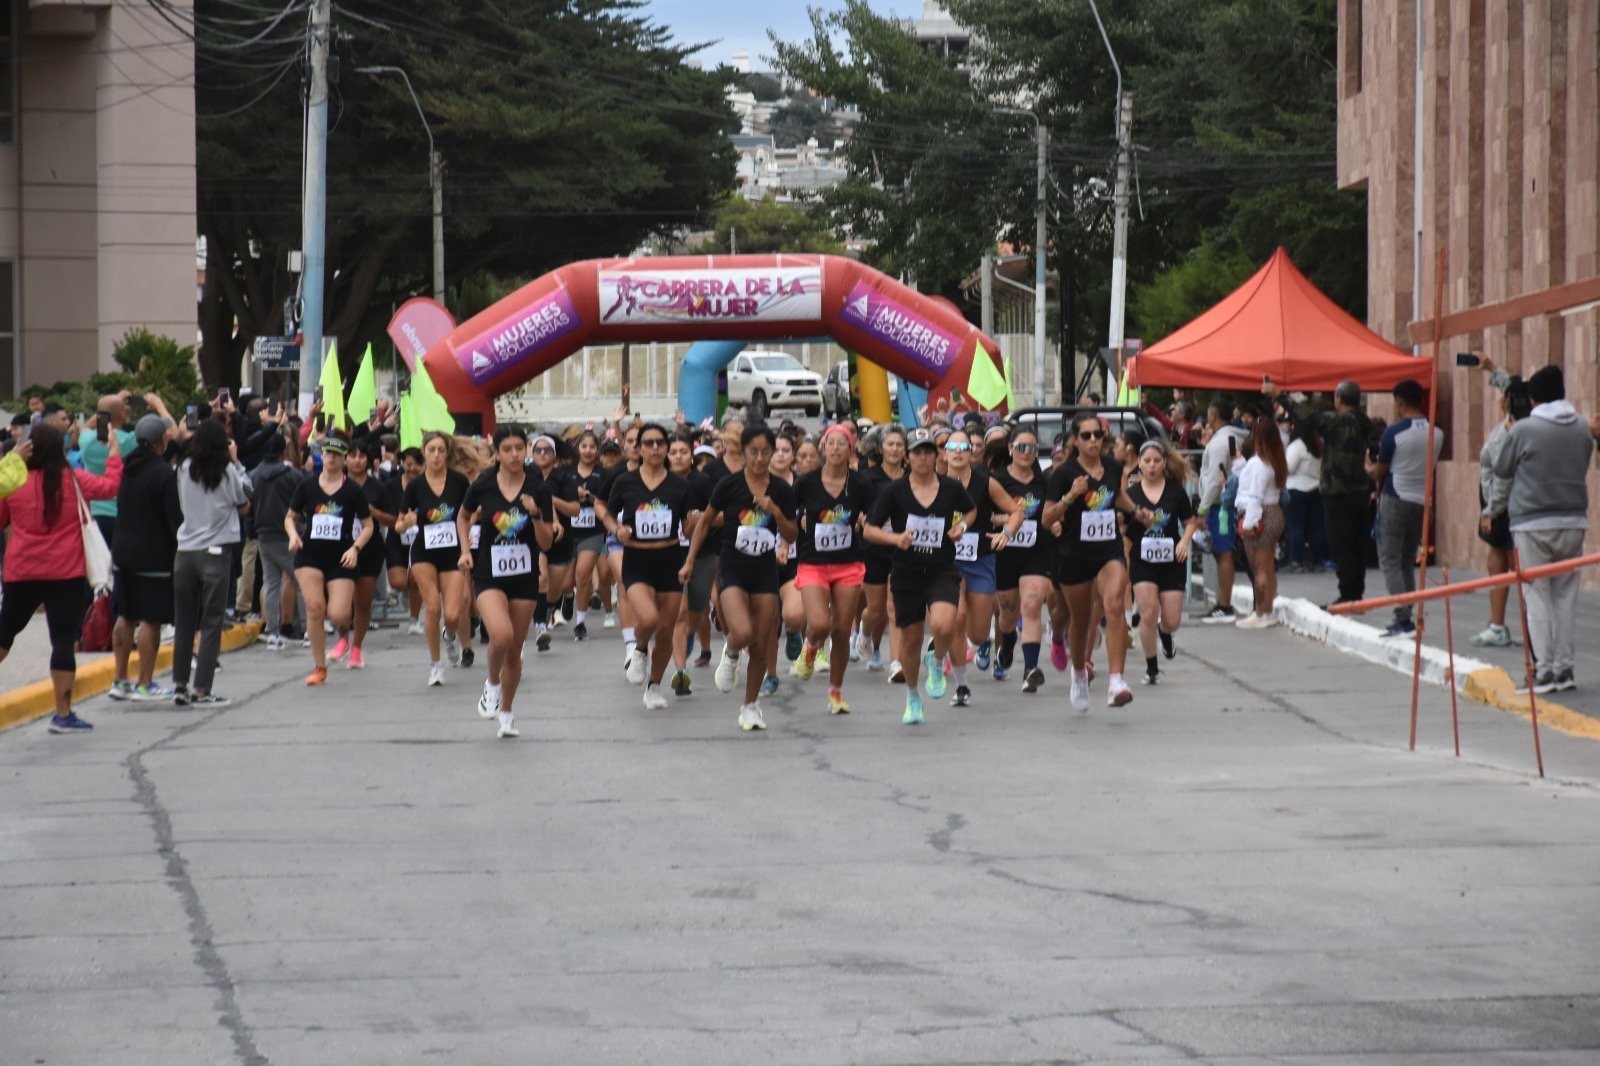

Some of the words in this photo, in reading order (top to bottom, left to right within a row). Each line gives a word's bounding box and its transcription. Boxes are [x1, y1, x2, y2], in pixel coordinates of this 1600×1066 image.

[640, 277, 740, 297] CARRERA
[745, 277, 771, 295] DE
[777, 277, 805, 295] LA
[688, 298, 758, 316] MUJER
[493, 301, 561, 351] MUJERES
[880, 306, 950, 353] MUJERES
[499, 313, 569, 361] SOLIDARIAS
[874, 318, 944, 366] SOLIDARIAS
[254, 352, 282, 360] Moreno
[315, 525, 338, 536] 085
[641, 522, 667, 535] 061
[1087, 523, 1113, 537] 015
[429, 532, 453, 545] 229
[741, 538, 769, 553] 218
[821, 534, 848, 548] 017
[1146, 548, 1171, 560] 062
[498, 556, 526, 571] 001
